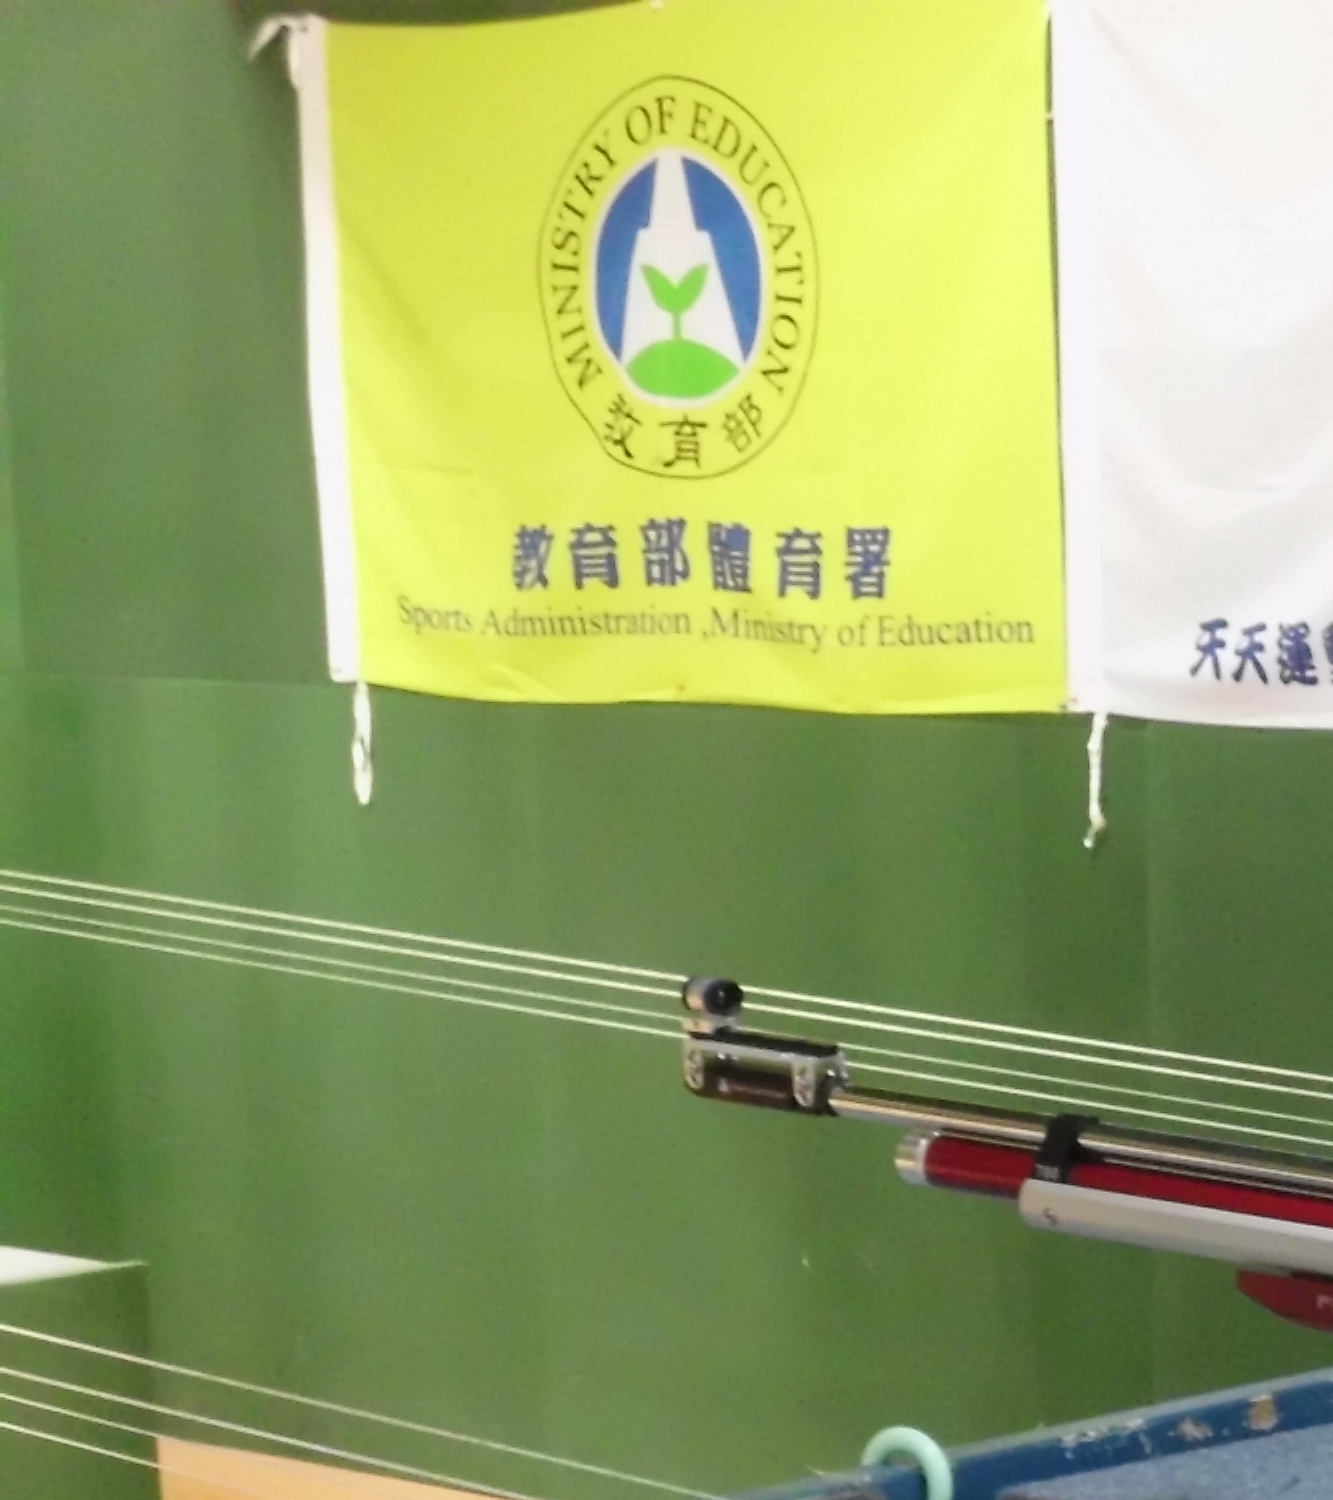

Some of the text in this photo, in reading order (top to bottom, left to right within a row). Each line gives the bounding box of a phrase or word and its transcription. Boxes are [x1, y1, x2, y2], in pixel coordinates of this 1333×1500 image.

[551, 96, 803, 391] MINISTRY OF EDUCATION
[603, 393, 763, 469] 教育部
[512, 517, 892, 600] 教育部體育署
[398, 595, 473, 634] Sports
[480, 606, 692, 637] Administration
[836, 612, 871, 647] of
[877, 611, 1035, 646] Education
